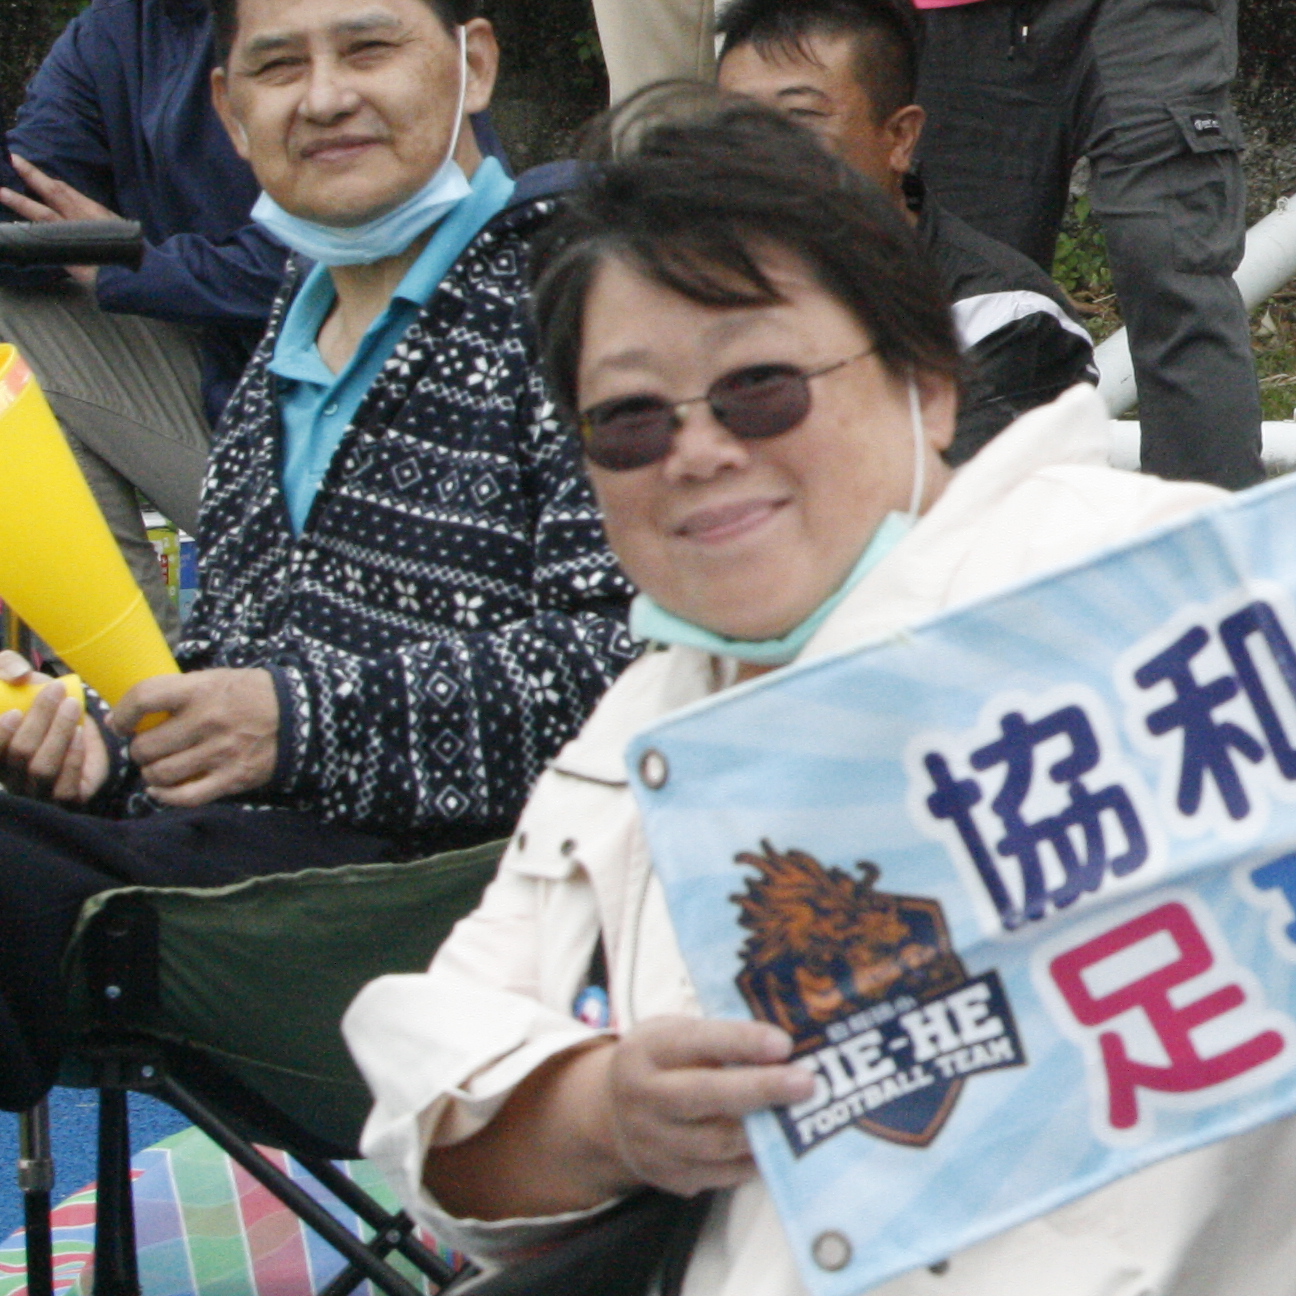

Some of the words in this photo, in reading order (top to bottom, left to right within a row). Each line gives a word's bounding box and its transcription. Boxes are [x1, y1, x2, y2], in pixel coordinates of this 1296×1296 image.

[788, 981, 1005, 1121] SIE-HE
[796, 1064, 935, 1145] FOOTBALL
[934, 1035, 1016, 1079] TEAM
